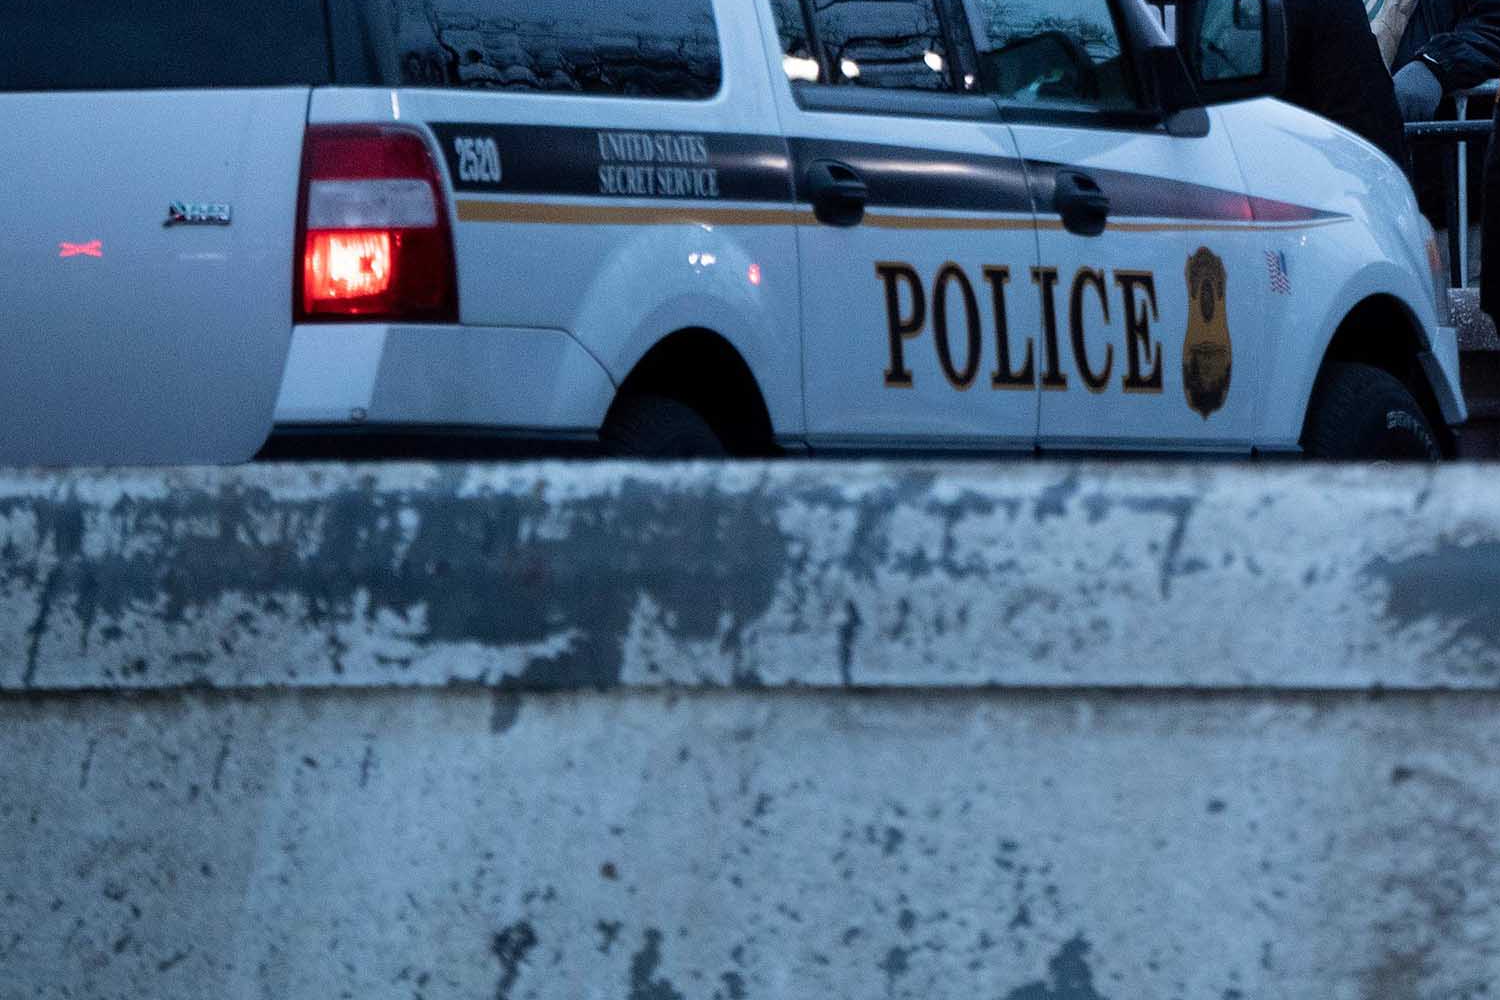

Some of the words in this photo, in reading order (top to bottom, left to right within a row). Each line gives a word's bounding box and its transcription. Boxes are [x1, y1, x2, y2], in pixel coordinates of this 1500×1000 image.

[454, 136, 501, 183] 2520
[598, 132, 653, 161] UNITED
[655, 133, 709, 164] STATES
[599, 165, 653, 194] SECRET
[656, 167, 720, 197] SERVICE
[874, 260, 1164, 394] POLICE
